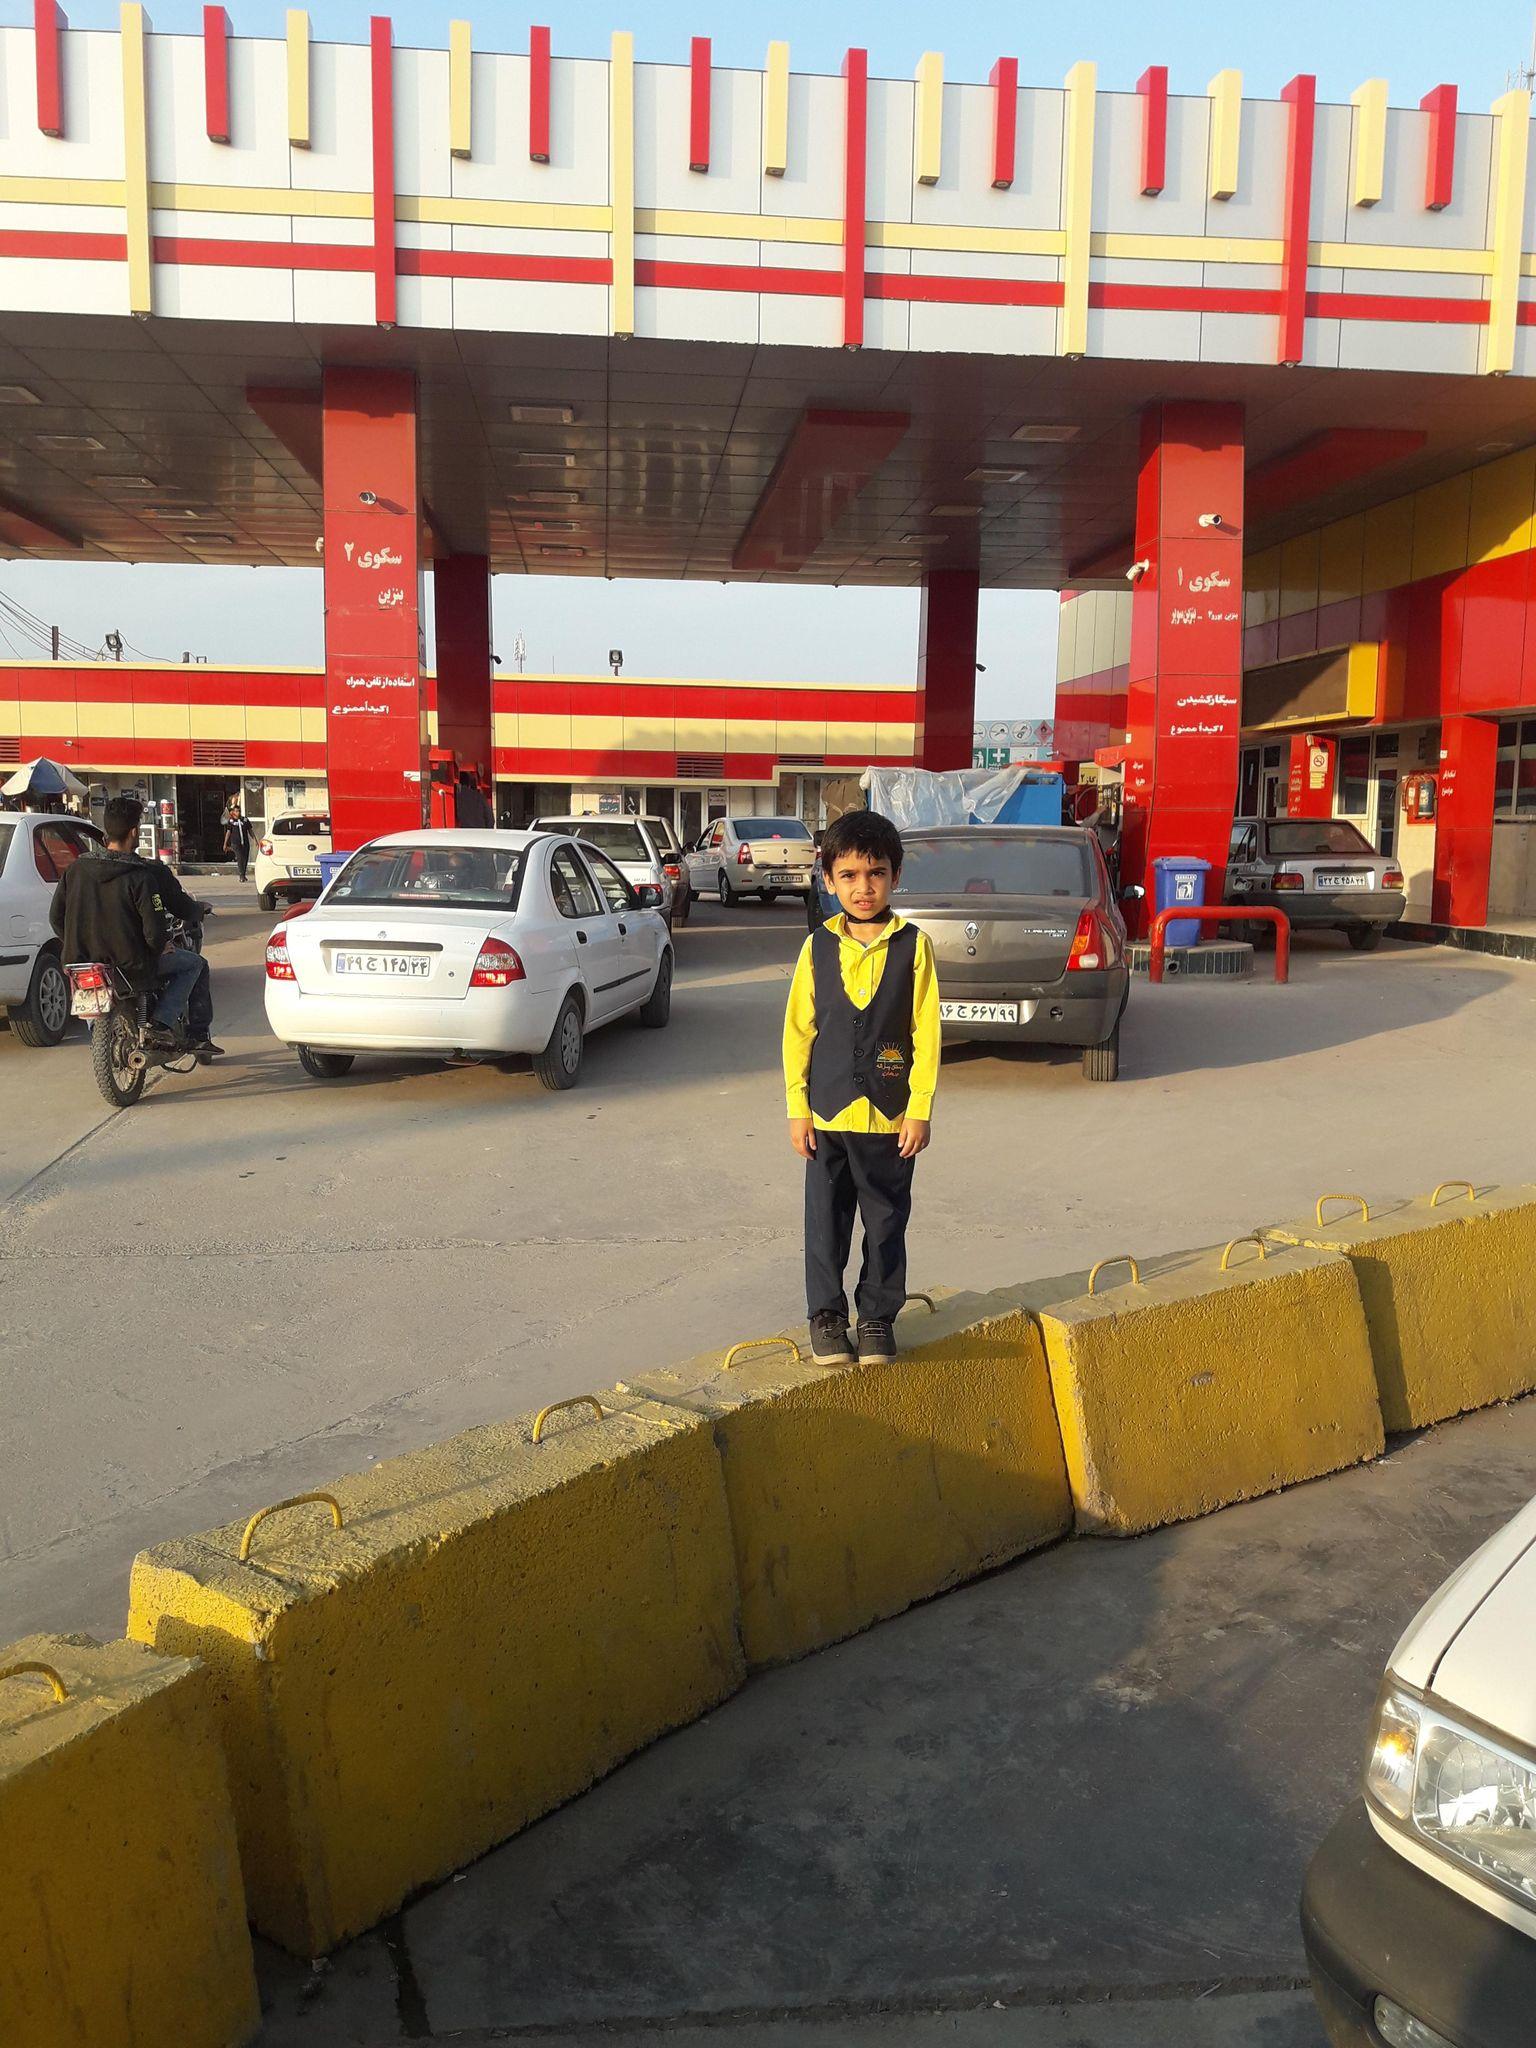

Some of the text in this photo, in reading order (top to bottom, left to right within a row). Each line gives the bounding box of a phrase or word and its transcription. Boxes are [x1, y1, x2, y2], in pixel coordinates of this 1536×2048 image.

[344, 542, 402, 569] سکوی ۲
[1177, 566, 1231, 592] سکوی ۱
[378, 588, 404, 606] بنزین
[346, 676, 365, 688] همراه
[365, 676, 381, 688] تلفن
[388, 677, 415, 687] استفاده
[1177, 694, 1213, 706] کشیدن
[332, 703, 365, 714] ممنوع
[1170, 724, 1198, 736] ممنوع
[346, 956, 428, 975] ۴۹ ج ۱۴۵ ۲۴
[957, 1005, 967, 1018] ج
[971, 1005, 996, 1019] ۶۶۷
[1000, 1009, 1015, 1021] ۹۹
